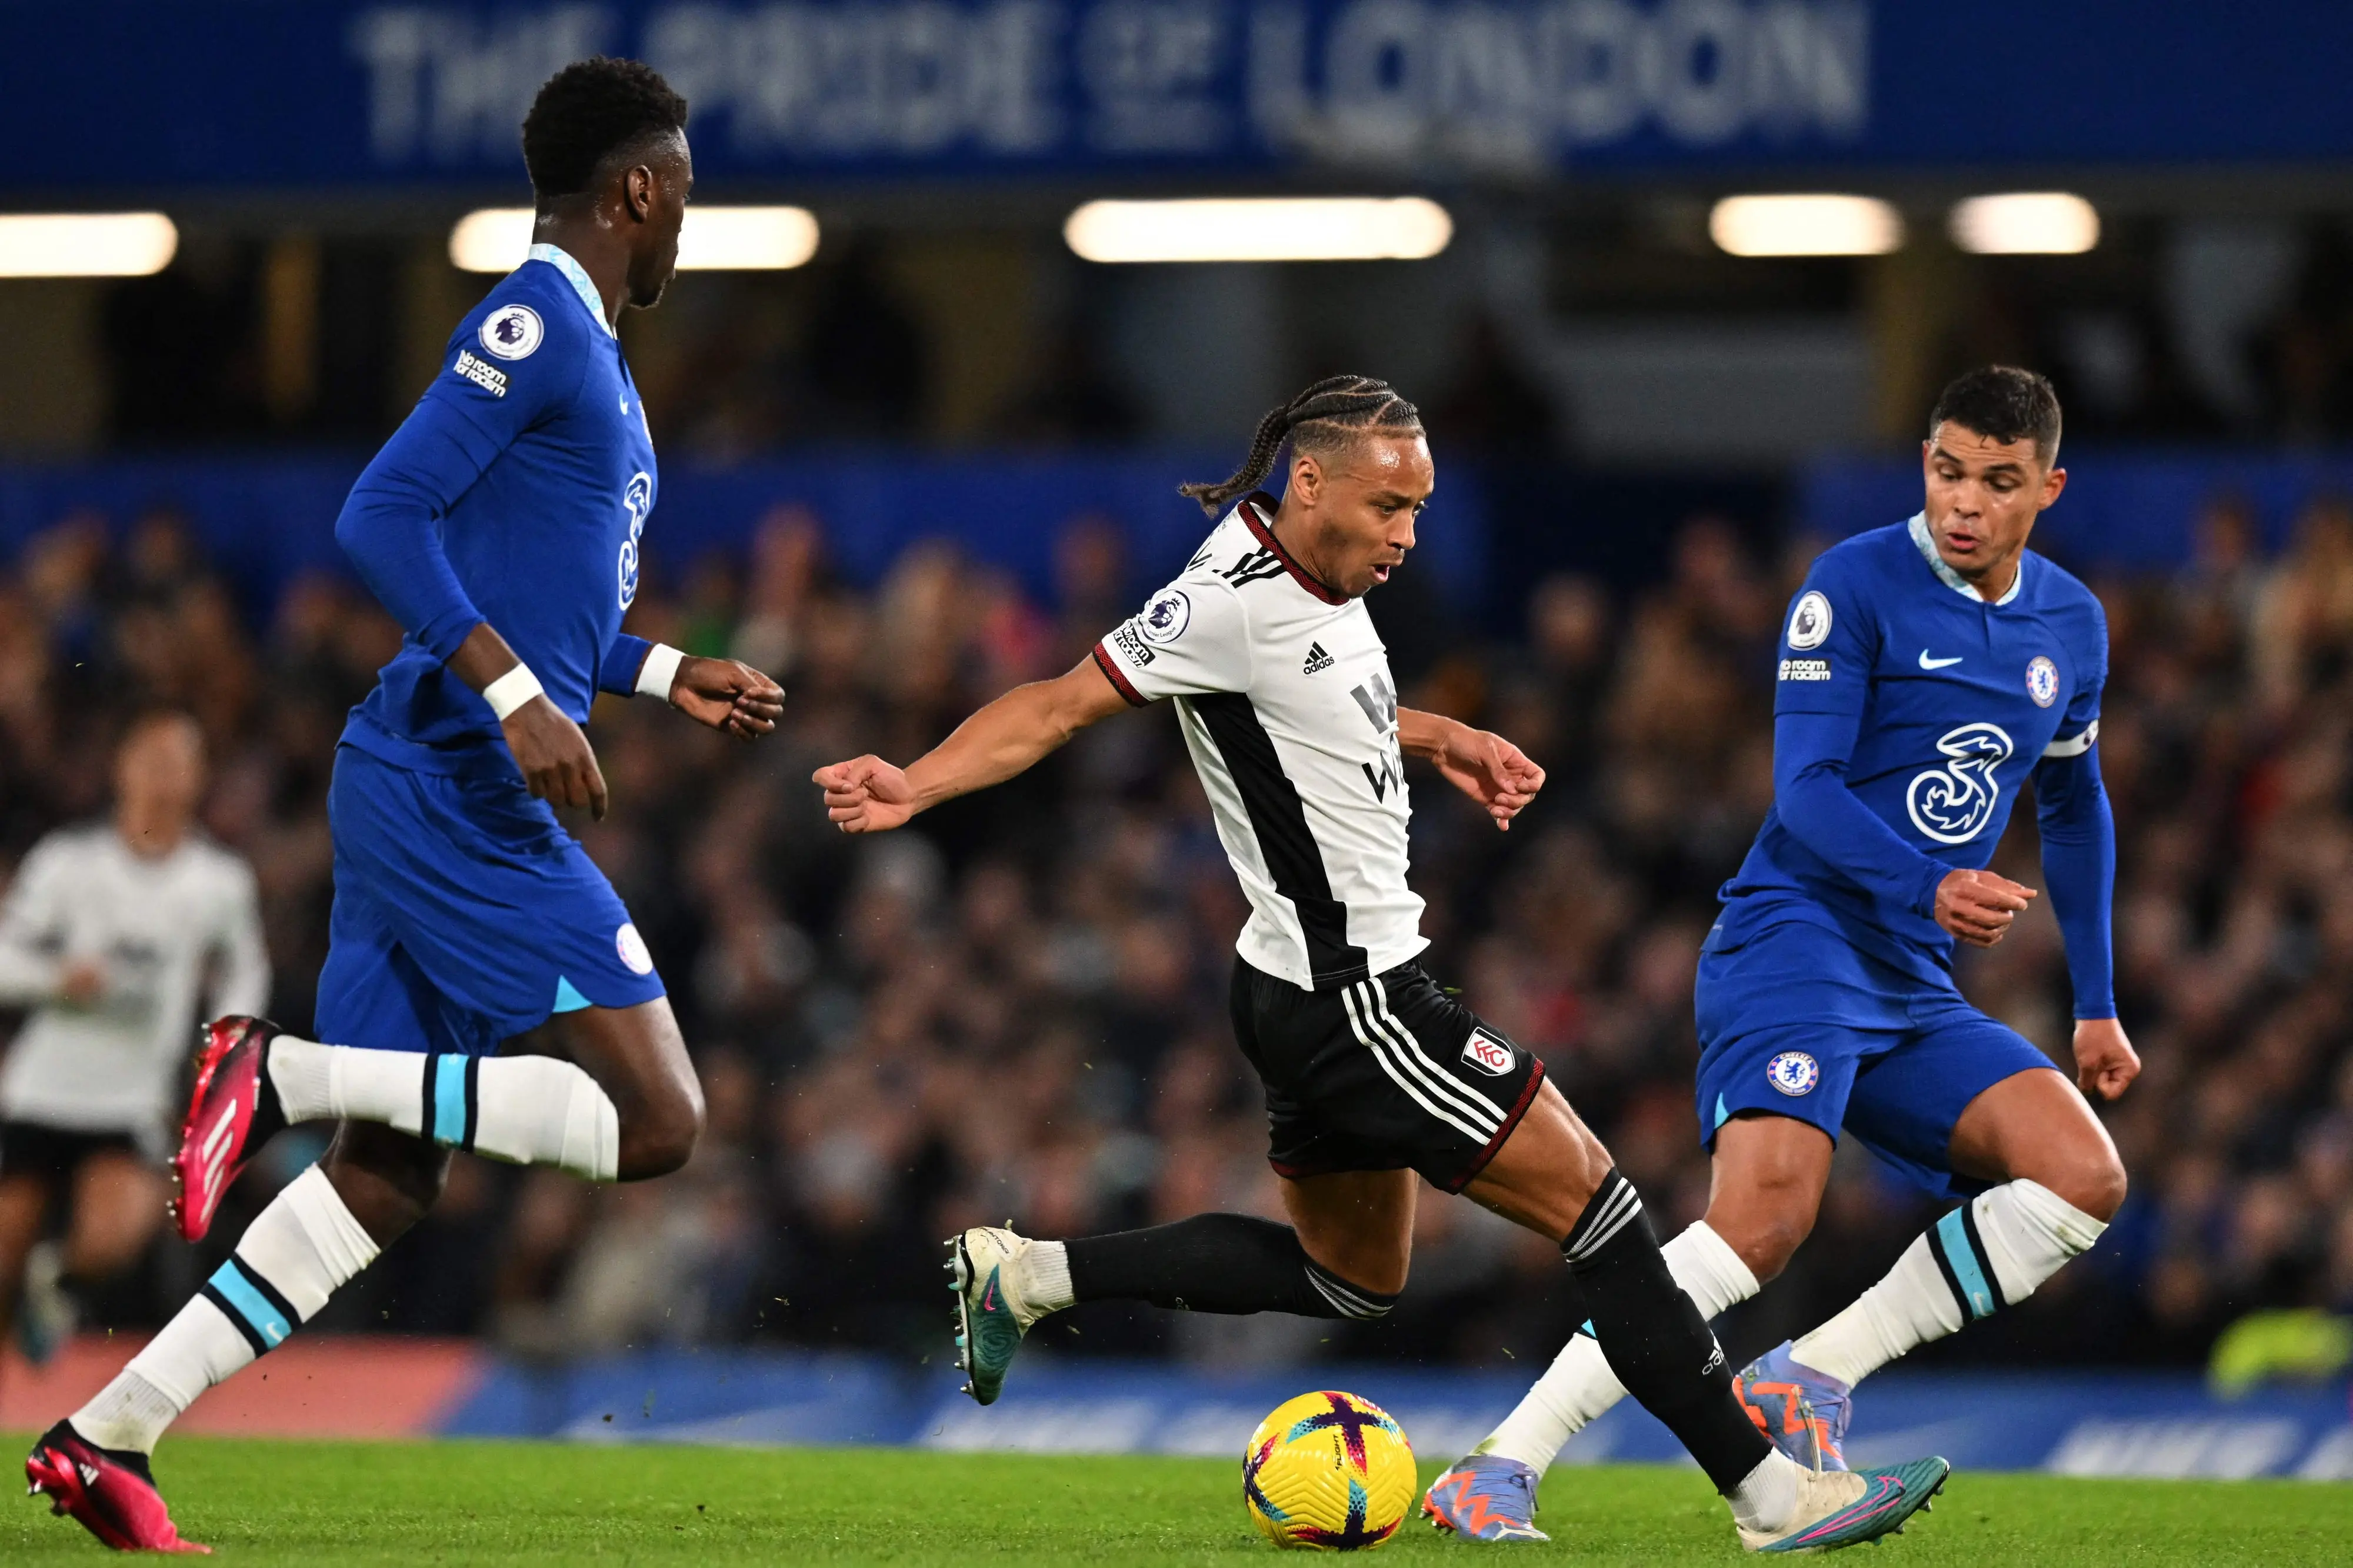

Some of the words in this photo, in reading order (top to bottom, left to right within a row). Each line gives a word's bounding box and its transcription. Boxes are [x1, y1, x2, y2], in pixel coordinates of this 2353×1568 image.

[646, 5, 1058, 154] PRIDE
[1248, 0, 1873, 151] LONDON
[472, 360, 506, 385] room
[1160, 626, 1176, 638] League
[1125, 635, 1149, 660] room
[1303, 656, 1335, 675] adidas
[1792, 660, 1826, 670] room
[1474, 1040, 1505, 1066] FFC
[1333, 1434, 1342, 1466] FLIGHT
